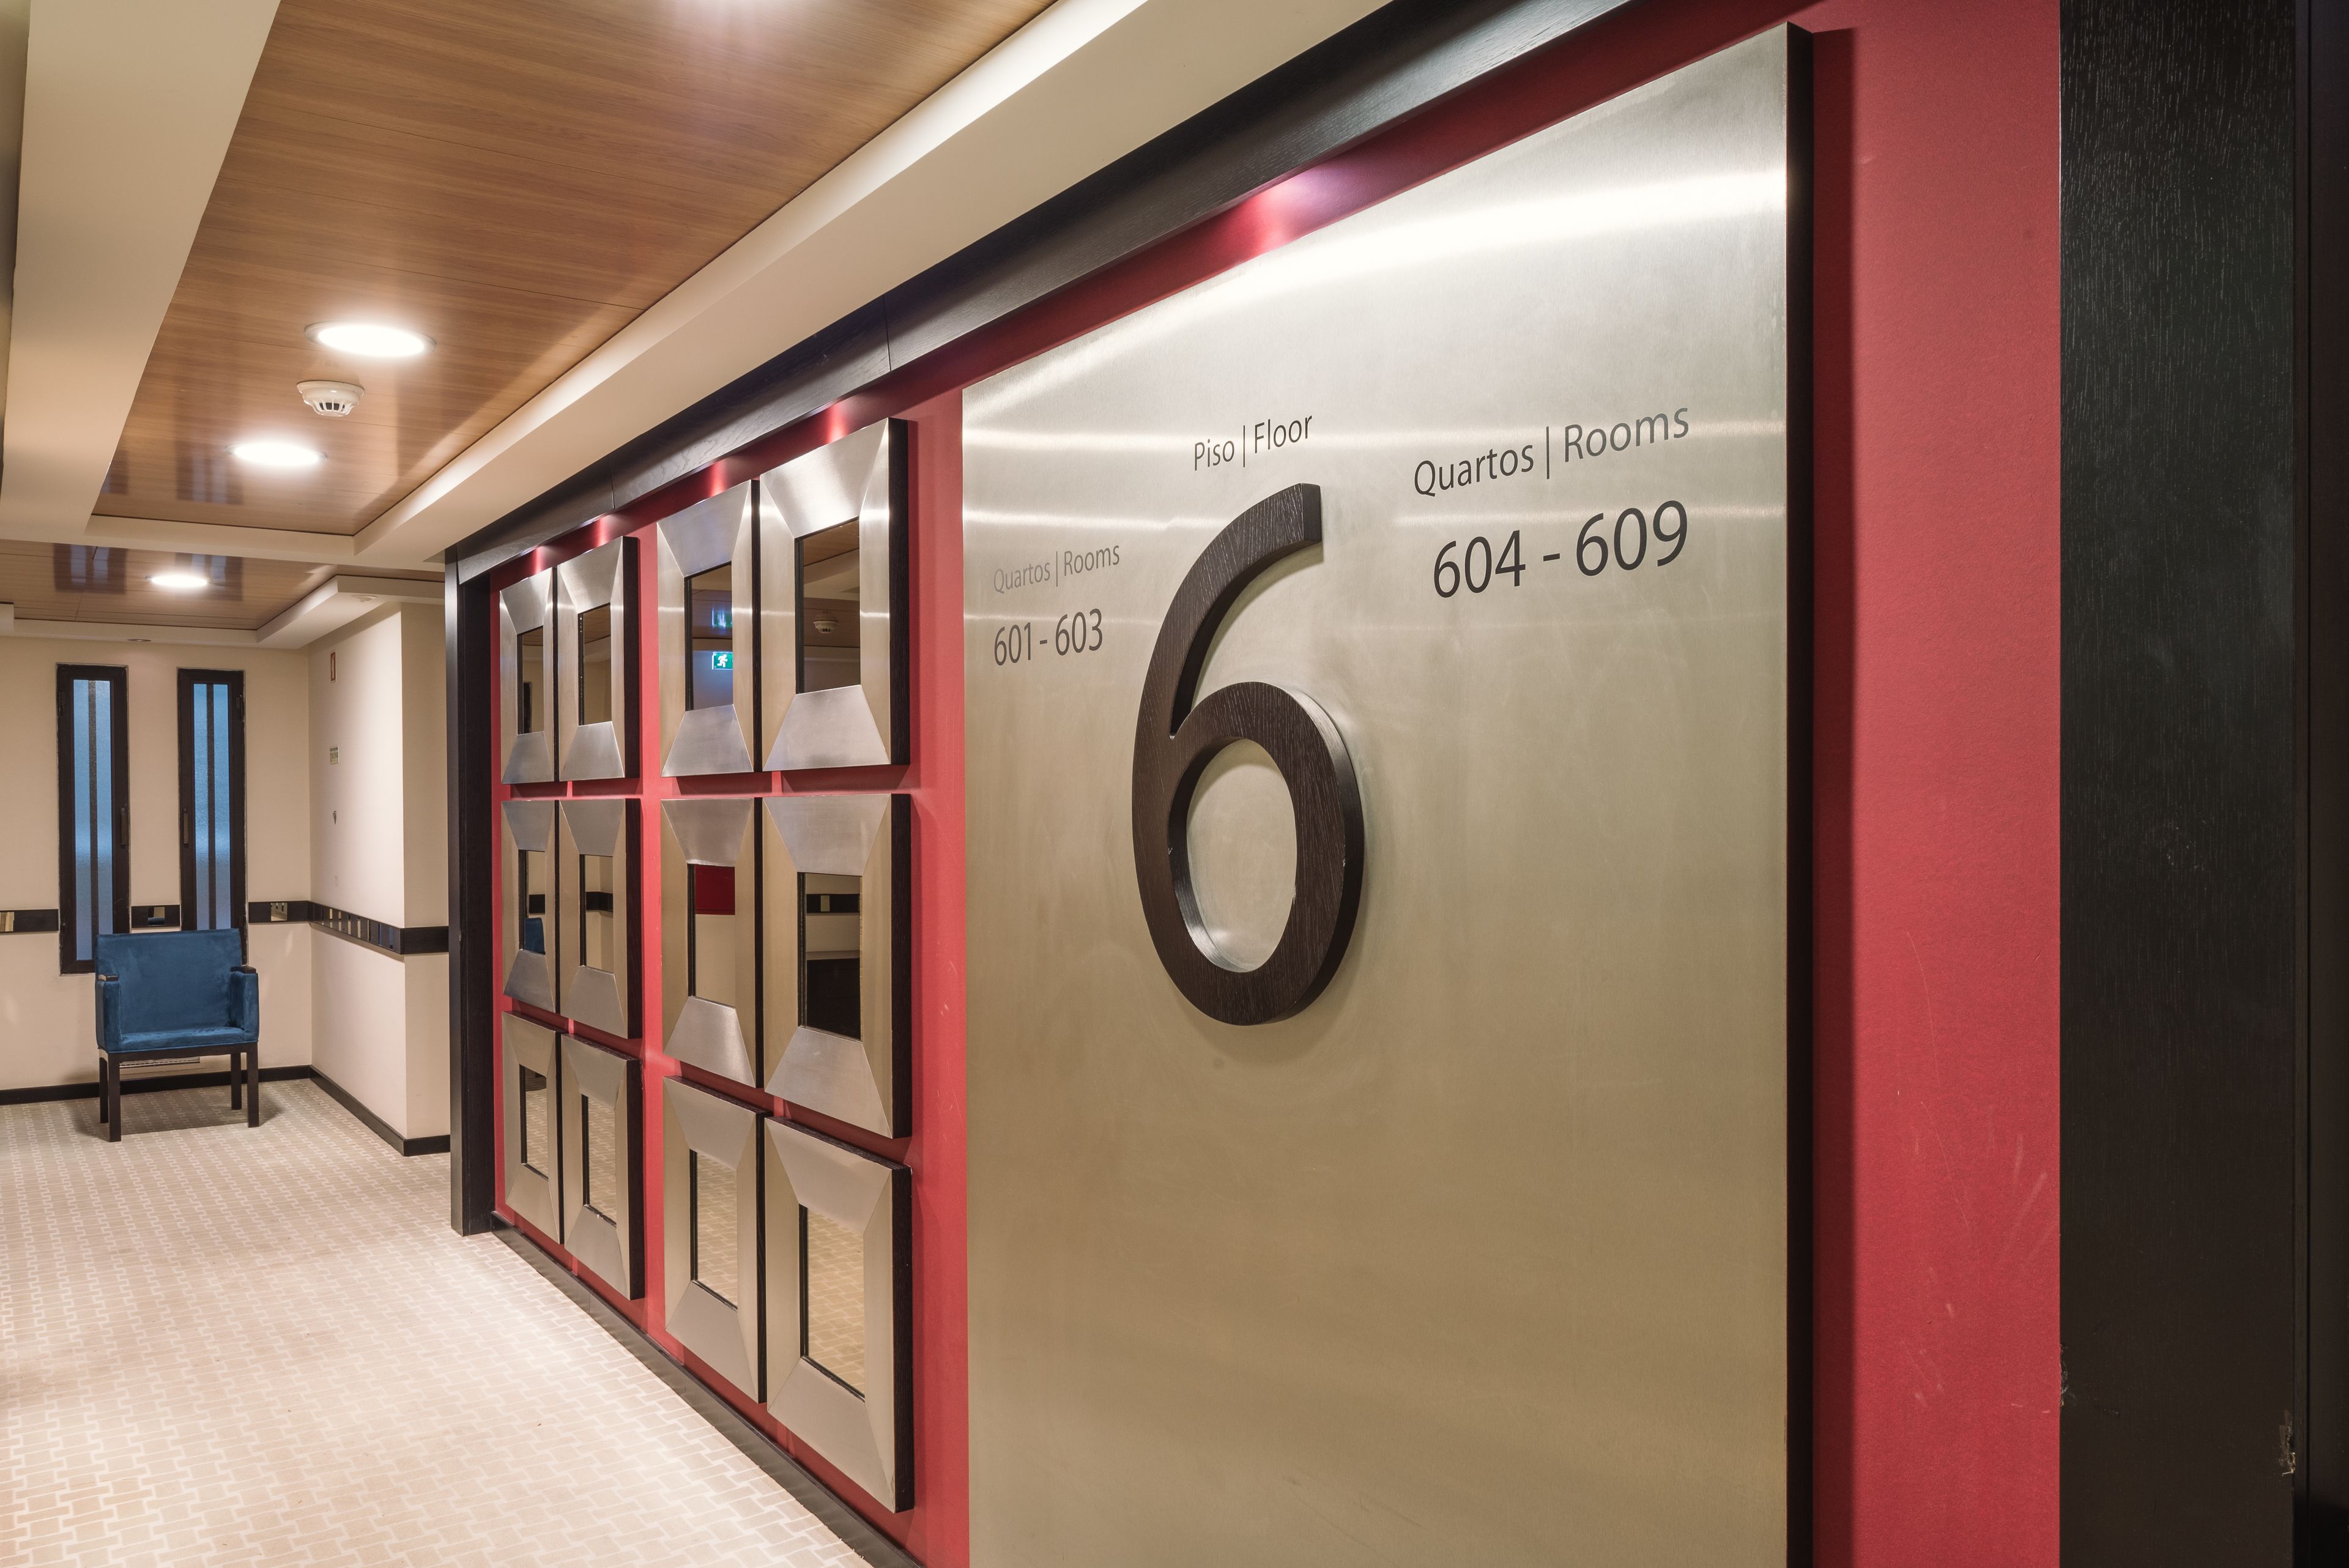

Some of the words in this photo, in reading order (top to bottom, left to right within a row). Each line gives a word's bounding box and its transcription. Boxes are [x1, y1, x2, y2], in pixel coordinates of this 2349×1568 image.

[1194, 438, 1235, 471] Piso
[1255, 415, 1312, 454] Floor
[1413, 444, 1535, 497] Quartos
[1564, 407, 1690, 463] Rooms
[993, 562, 1051, 595] Quartos
[1064, 545, 1120, 576] Rooms
[1433, 529, 1526, 598] 604
[1576, 499, 1688, 577] 609
[994, 622, 1031, 666] 601
[1055, 608, 1103, 656] 603
[1132, 483, 1364, 1026] 6
